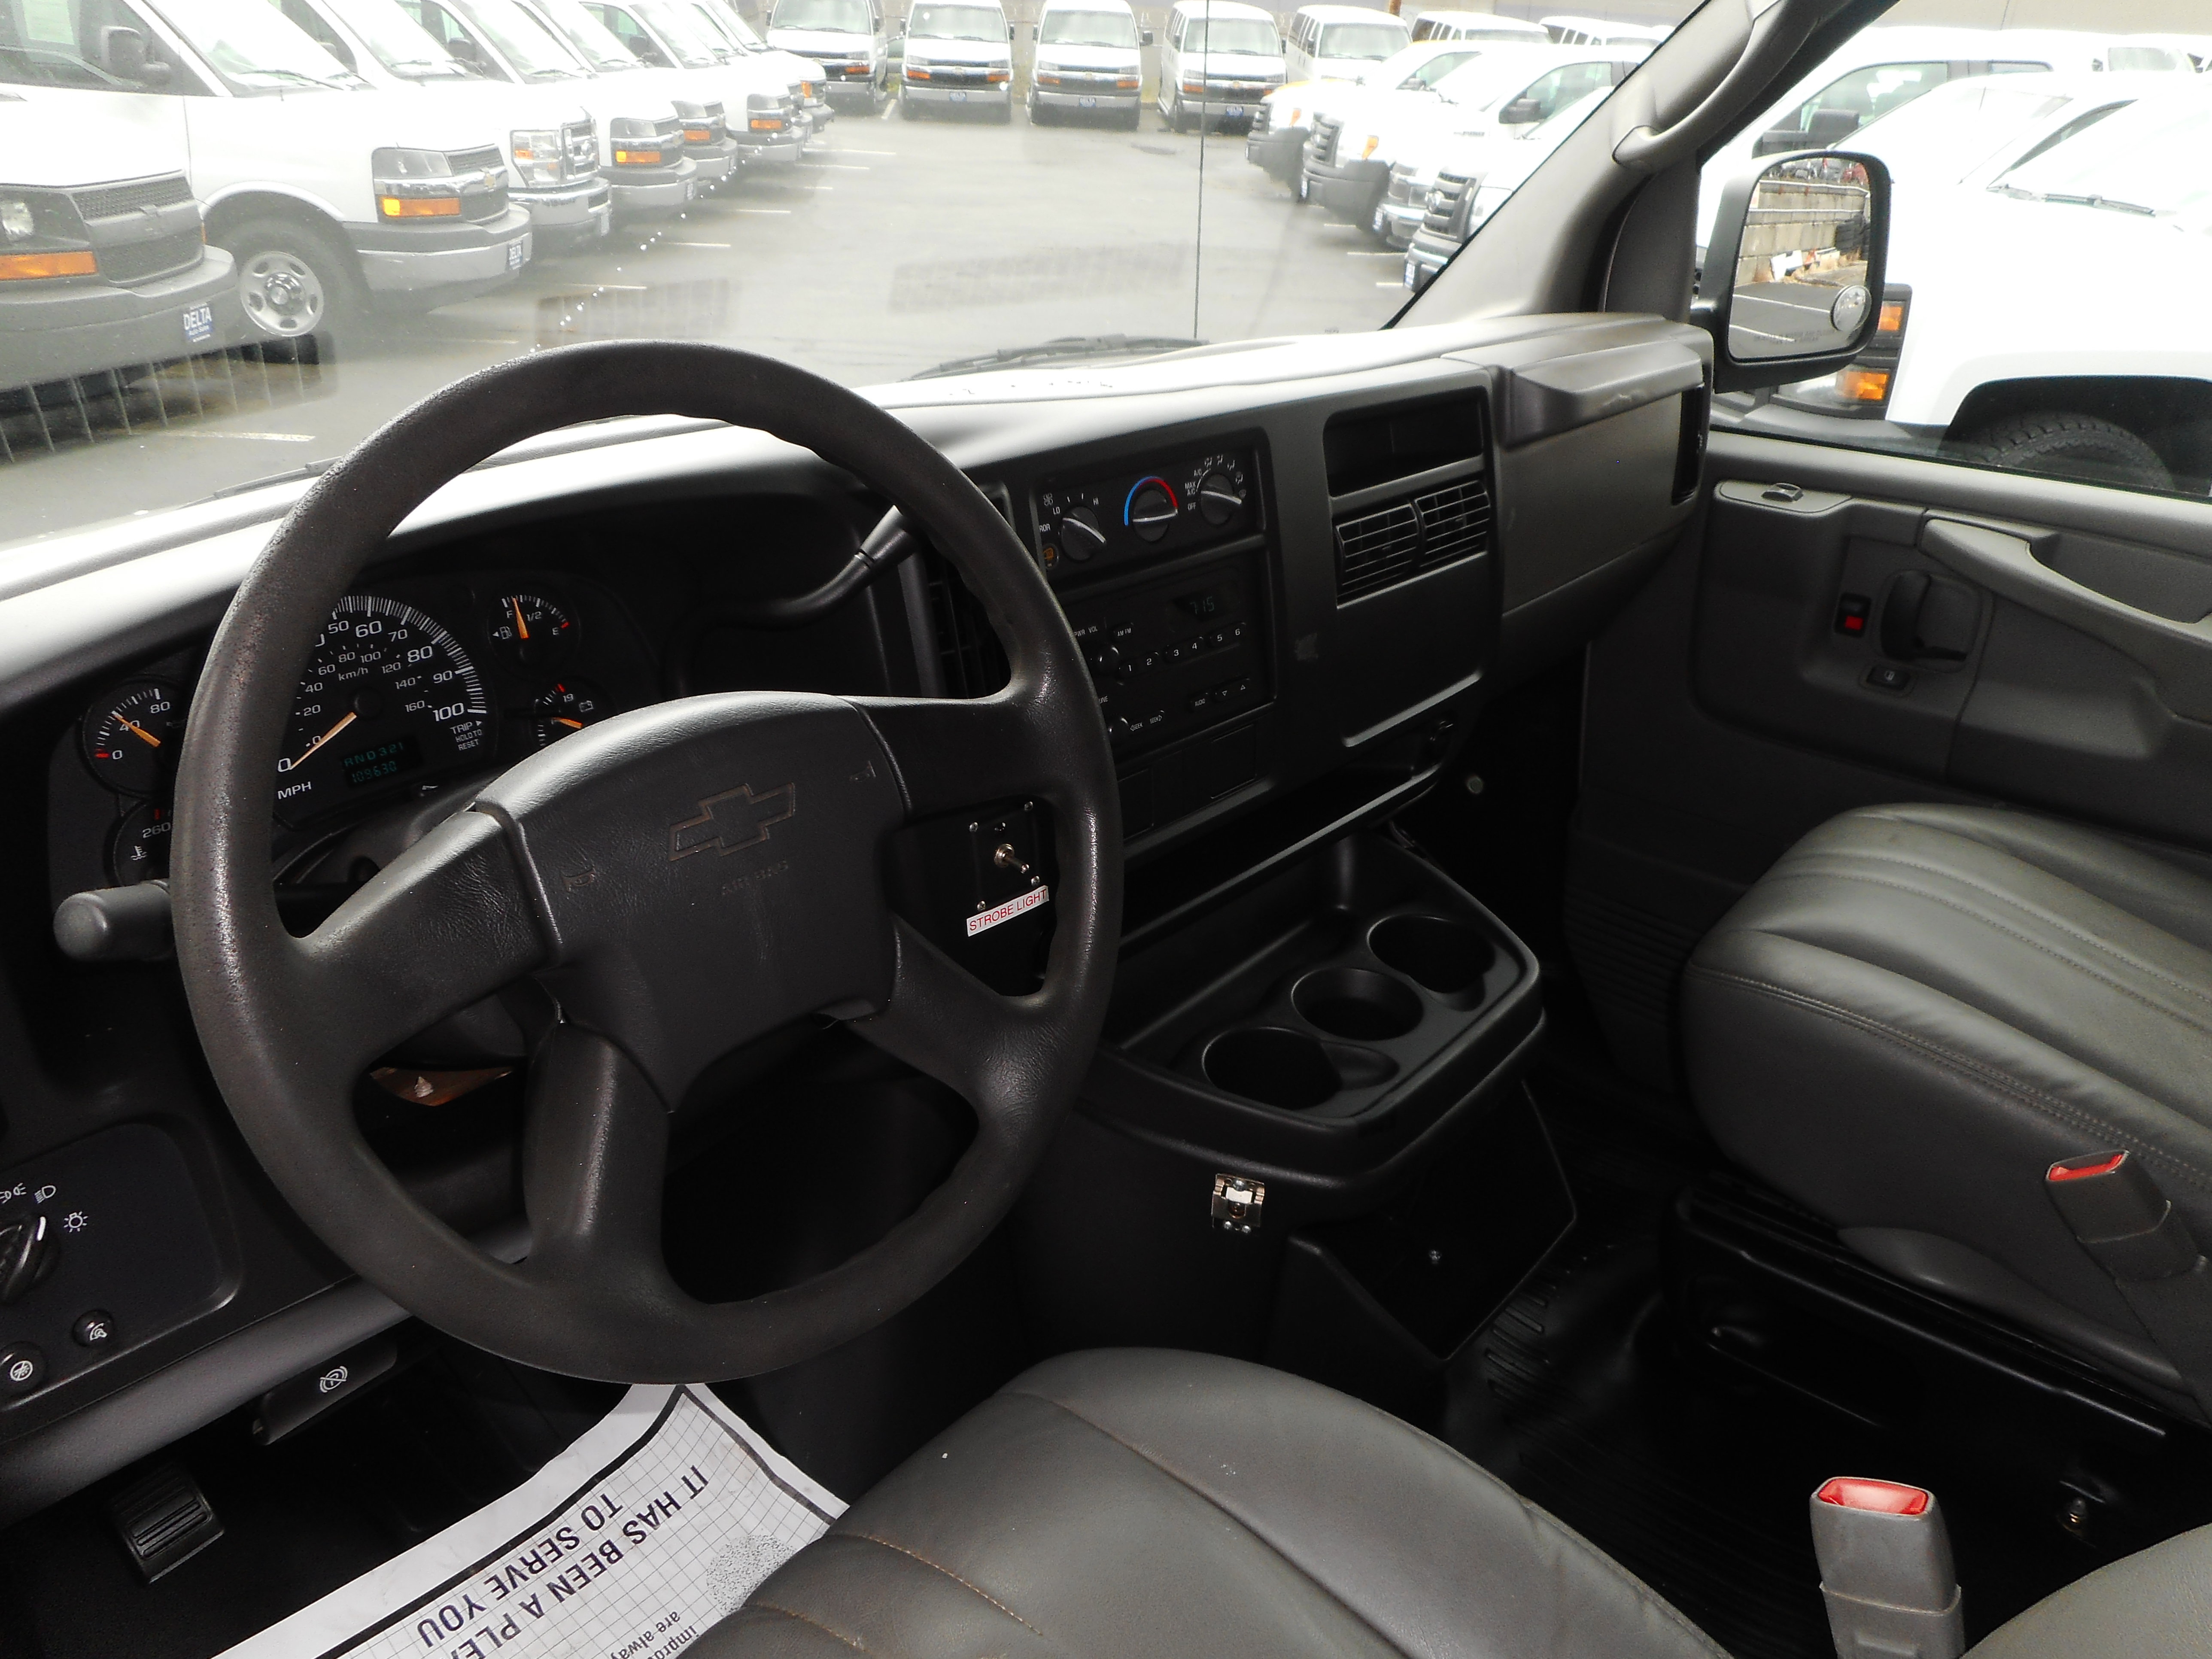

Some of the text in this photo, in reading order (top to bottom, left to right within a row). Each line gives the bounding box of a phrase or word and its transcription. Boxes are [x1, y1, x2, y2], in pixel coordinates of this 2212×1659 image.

[183, 307, 212, 330] DELTA
[1193, 468, 1202, 477] A/C
[1185, 481, 1196, 489] MAX
[1093, 497, 1099, 505] HI
[1188, 502, 1197, 511] OFF
[1053, 506, 1060, 515] LO
[328, 620, 350, 634] 50
[355, 620, 382, 638] 60
[526, 611, 542, 621] 1/2
[552, 627, 559, 635] E
[388, 629, 408, 642] 70
[1217, 634, 1223, 642] 5
[338, 651, 356, 663] 80
[360, 651, 381, 663] 100
[407, 645, 433, 662] 80
[318, 664, 336, 676] 60
[338, 667, 369, 681] km/h
[381, 662, 401, 674] 120
[395, 677, 416, 690] 140
[433, 670, 453, 684] 90
[304, 682, 323, 693] 40
[150, 701, 171, 714] 80
[303, 704, 322, 716] 20
[405, 700, 425, 713] 160
[432, 702, 465, 722] 100
[450, 722, 473, 734] TRIP
[455, 729, 482, 742] HOLD TO
[458, 738, 479, 750] RESET
[112, 749, 123, 760] 0
[277, 757, 292, 773] 0
[277, 781, 312, 799] MPH
[142, 821, 171, 839] 260
[969, 888, 1047, 931] STROBE LIGHT
[681, 1465, 709, 1500] IT
[622, 1491, 682, 1545] HAS
[416, 1493, 624, 1648] TO SERVE YOU
[546, 1539, 624, 1603] BEEN
[518, 1592, 545, 1619] A
[656, 1611, 681, 1633] are
